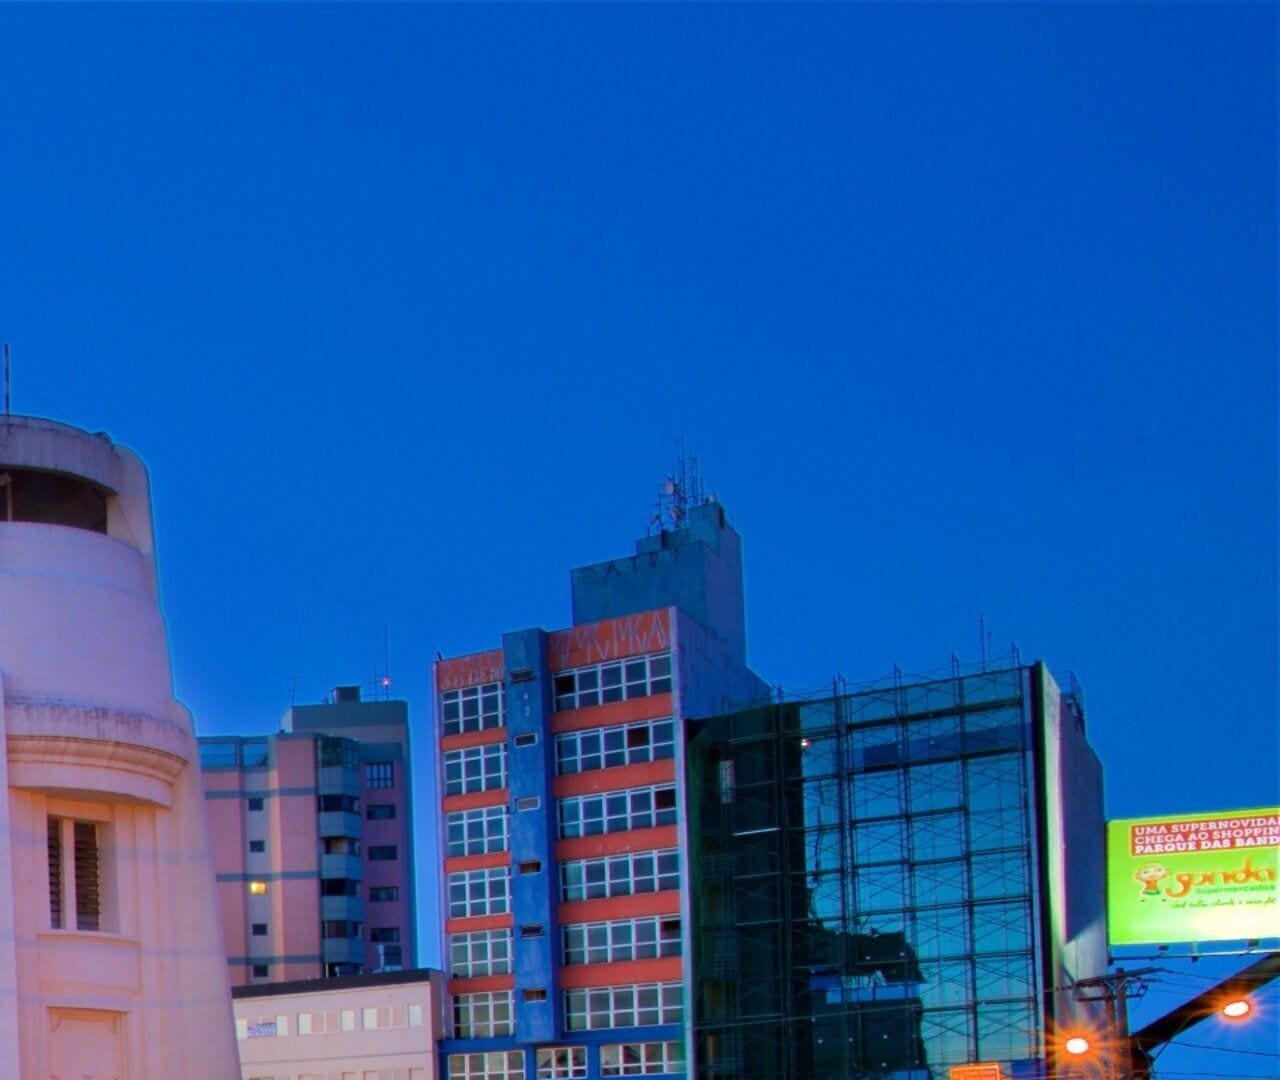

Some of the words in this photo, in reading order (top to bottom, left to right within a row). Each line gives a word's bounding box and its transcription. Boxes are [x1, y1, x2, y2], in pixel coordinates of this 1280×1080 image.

[1135, 825, 1171, 836] UMA
[1171, 817, 1280, 833] SUPERNOVIDA
[1135, 834, 1184, 844] CHEGA
[1188, 831, 1209, 842] AO
[1135, 842, 1197, 853] PARQUE
[1200, 838, 1232, 850] DAS
[1194, 883, 1276, 895] Supermercados
